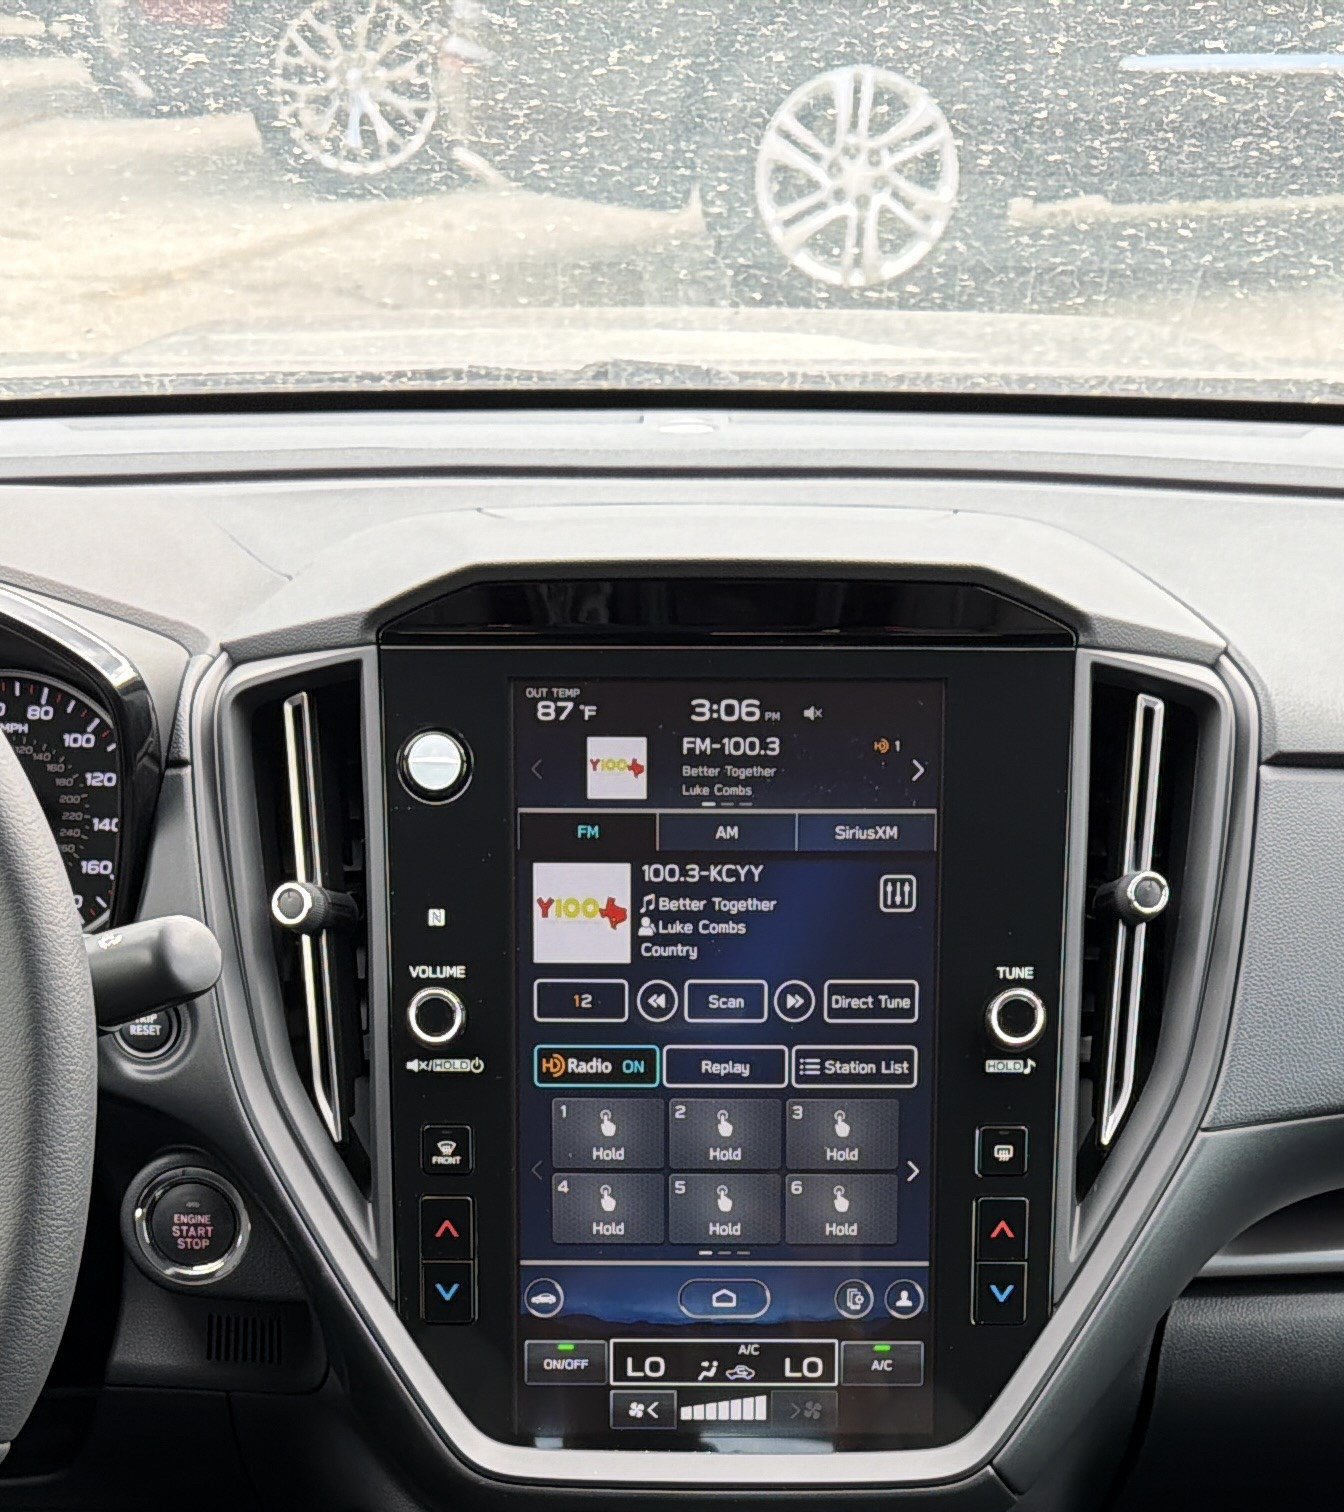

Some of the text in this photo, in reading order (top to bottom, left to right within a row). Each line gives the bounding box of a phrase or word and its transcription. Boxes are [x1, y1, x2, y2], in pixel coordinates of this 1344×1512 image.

[525, 687, 580, 698] OUT TEMP
[26, 704, 54, 720] 80
[536, 700, 574, 721] 87
[690, 698, 781, 722] 3:06 PM
[62, 732, 96, 748] 100
[682, 736, 781, 756] FM-100.3
[32, 752, 52, 762] 140
[589, 757, 628, 773] Y100
[682, 765, 777, 780] Better Together
[85, 771, 117, 787] 120
[682, 783, 752, 796] Luke Combs
[59, 794, 81, 804] 200
[62, 811, 84, 821] 220
[59, 828, 81, 838] 240
[577, 824, 600, 839] FM
[715, 825, 739, 840] AM
[834, 825, 899, 841] SiriusXM
[80, 859, 113, 875] 160
[641, 864, 764, 883] 100.3-KCYY
[536, 896, 600, 919] Y100
[658, 897, 777, 915] Better Together
[658, 920, 747, 935] Luke Combs
[640, 942, 698, 960] Country
[408, 965, 466, 979] VOLUME
[996, 965, 1034, 980] TUNE
[708, 995, 745, 1010] Scan
[831, 994, 911, 1010] Direct Tune
[129, 1024, 162, 1036] RESET
[567, 1058, 612, 1074] Radio
[622, 1059, 645, 1074] ON
[701, 1060, 751, 1077] Replay
[824, 1059, 910, 1076] Station List
[987, 1060, 1023, 1072] HOLD
[560, 1105, 567, 1119] 1
[674, 1105, 687, 1119] 2
[792, 1106, 804, 1120] 3
[432, 1155, 461, 1165] FRONT
[592, 1146, 625, 1162] Hold
[709, 1146, 742, 1162] Hold
[826, 1146, 859, 1162] Hold
[557, 1180, 570, 1194] 4
[674, 1181, 687, 1195] 5
[791, 1181, 803, 1195] 6
[173, 1213, 212, 1225] ENGINE
[171, 1225, 214, 1238] START
[592, 1221, 625, 1237] Hold
[708, 1221, 741, 1237] Hold
[825, 1221, 858, 1237] Hold
[177, 1236, 210, 1250] STOP
[738, 1344, 760, 1356] A/C
[543, 1358, 589, 1371] ON/OFF
[626, 1356, 665, 1378] LO
[784, 1356, 823, 1378] LO
[871, 1359, 893, 1371] A/C
